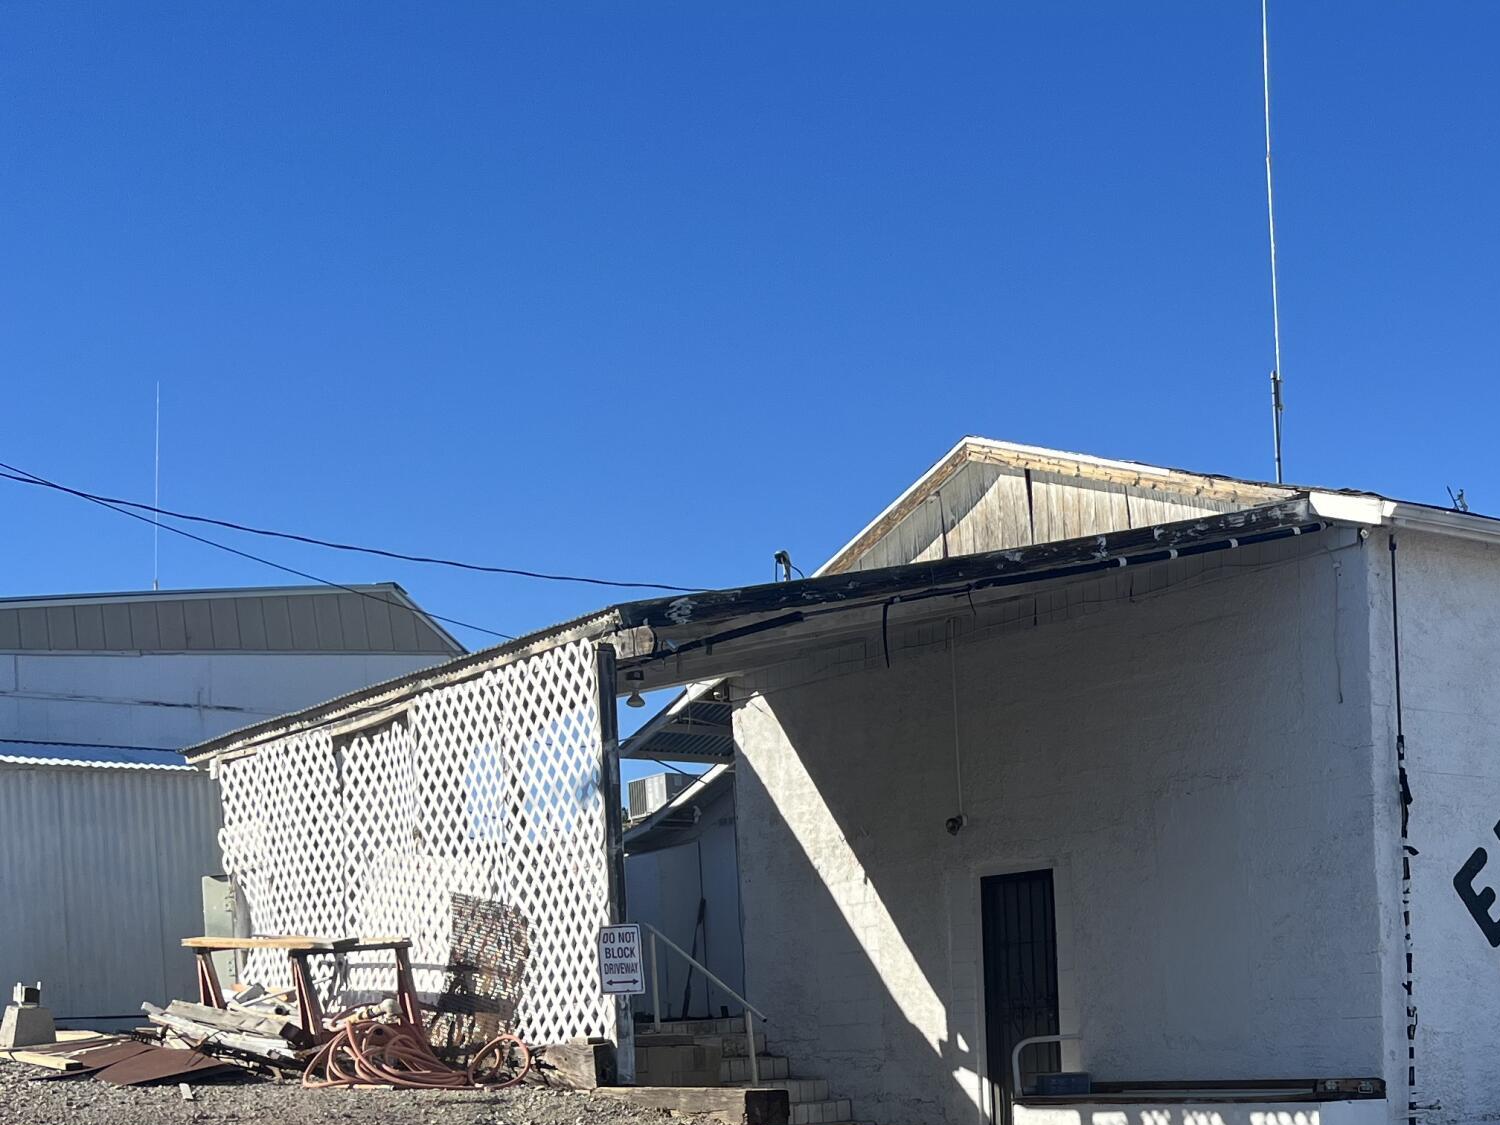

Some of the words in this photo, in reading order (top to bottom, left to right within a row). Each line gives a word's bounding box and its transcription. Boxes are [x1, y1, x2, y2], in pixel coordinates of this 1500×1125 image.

[602, 932, 615, 944] DO
[618, 931, 636, 943] NOT
[605, 947, 636, 959] BLOCK
[604, 963, 638, 975] DRIVEWAY
